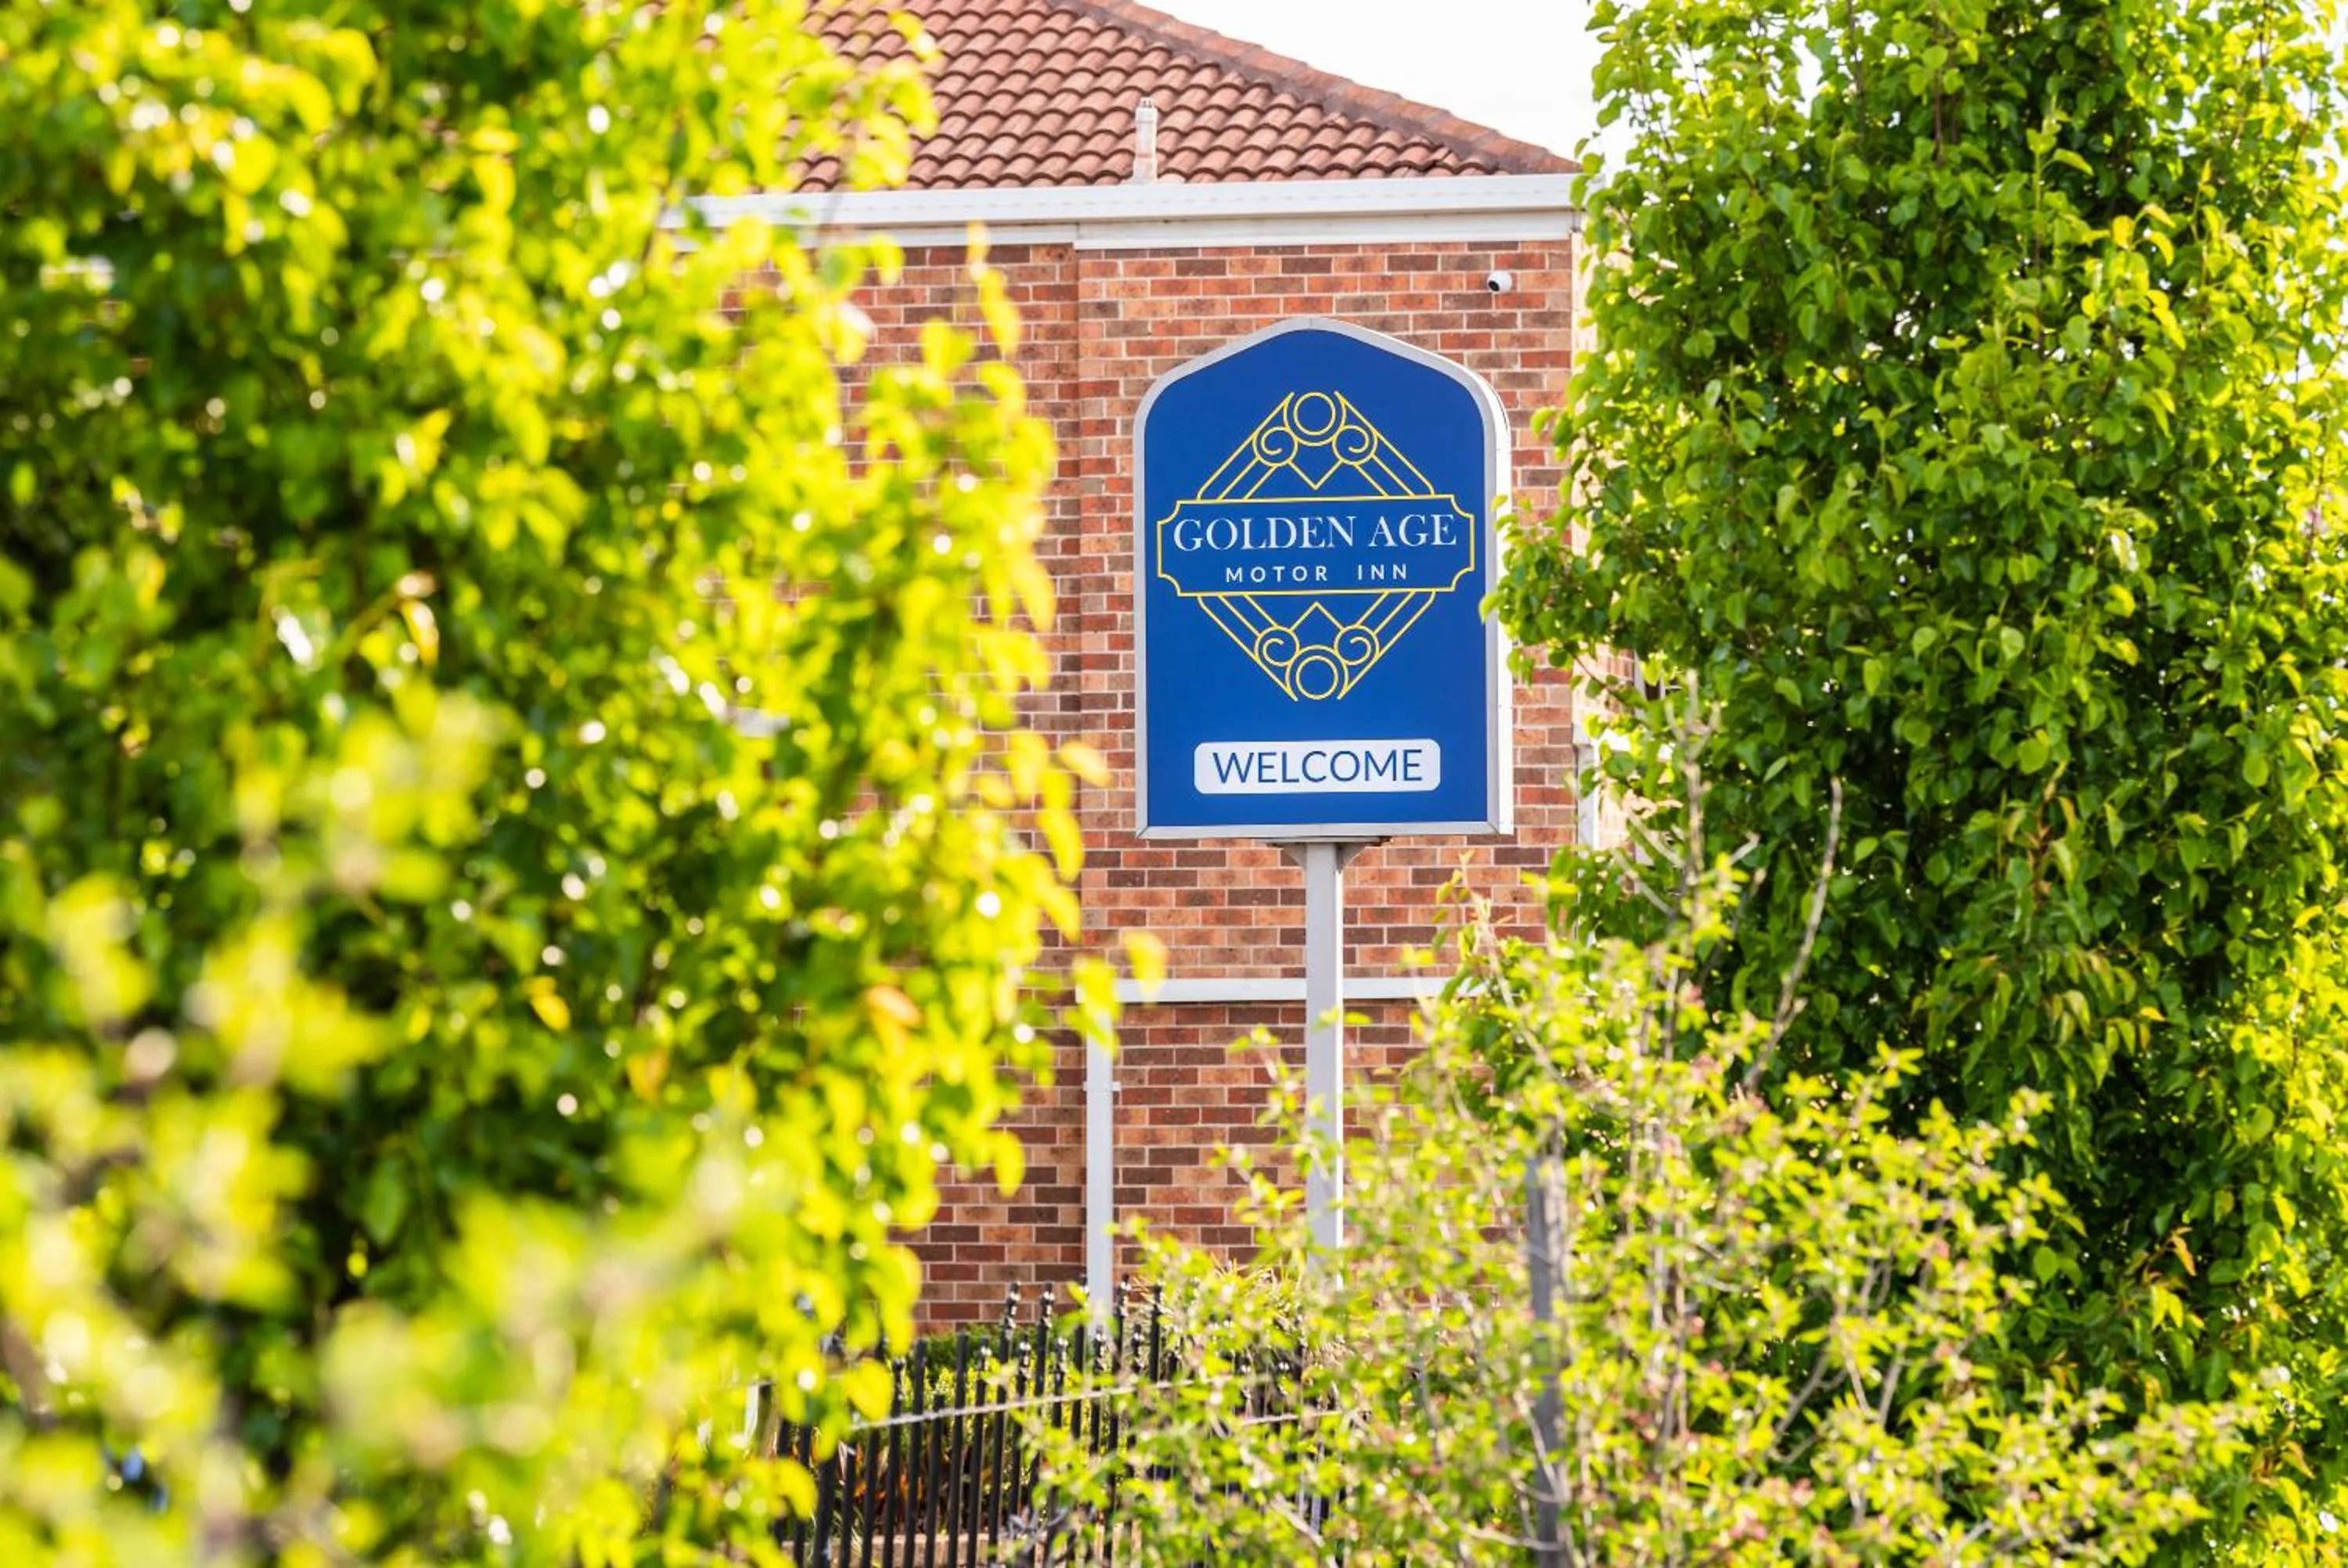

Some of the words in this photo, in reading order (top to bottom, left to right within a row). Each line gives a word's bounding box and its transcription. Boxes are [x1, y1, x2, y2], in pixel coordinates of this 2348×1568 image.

[1173, 516, 1355, 551] GOLDEN
[1368, 513, 1457, 548] AGE
[1226, 566, 1328, 583] MOTOR
[1357, 563, 1407, 581] INN
[1212, 749, 1423, 783] WELCOME
